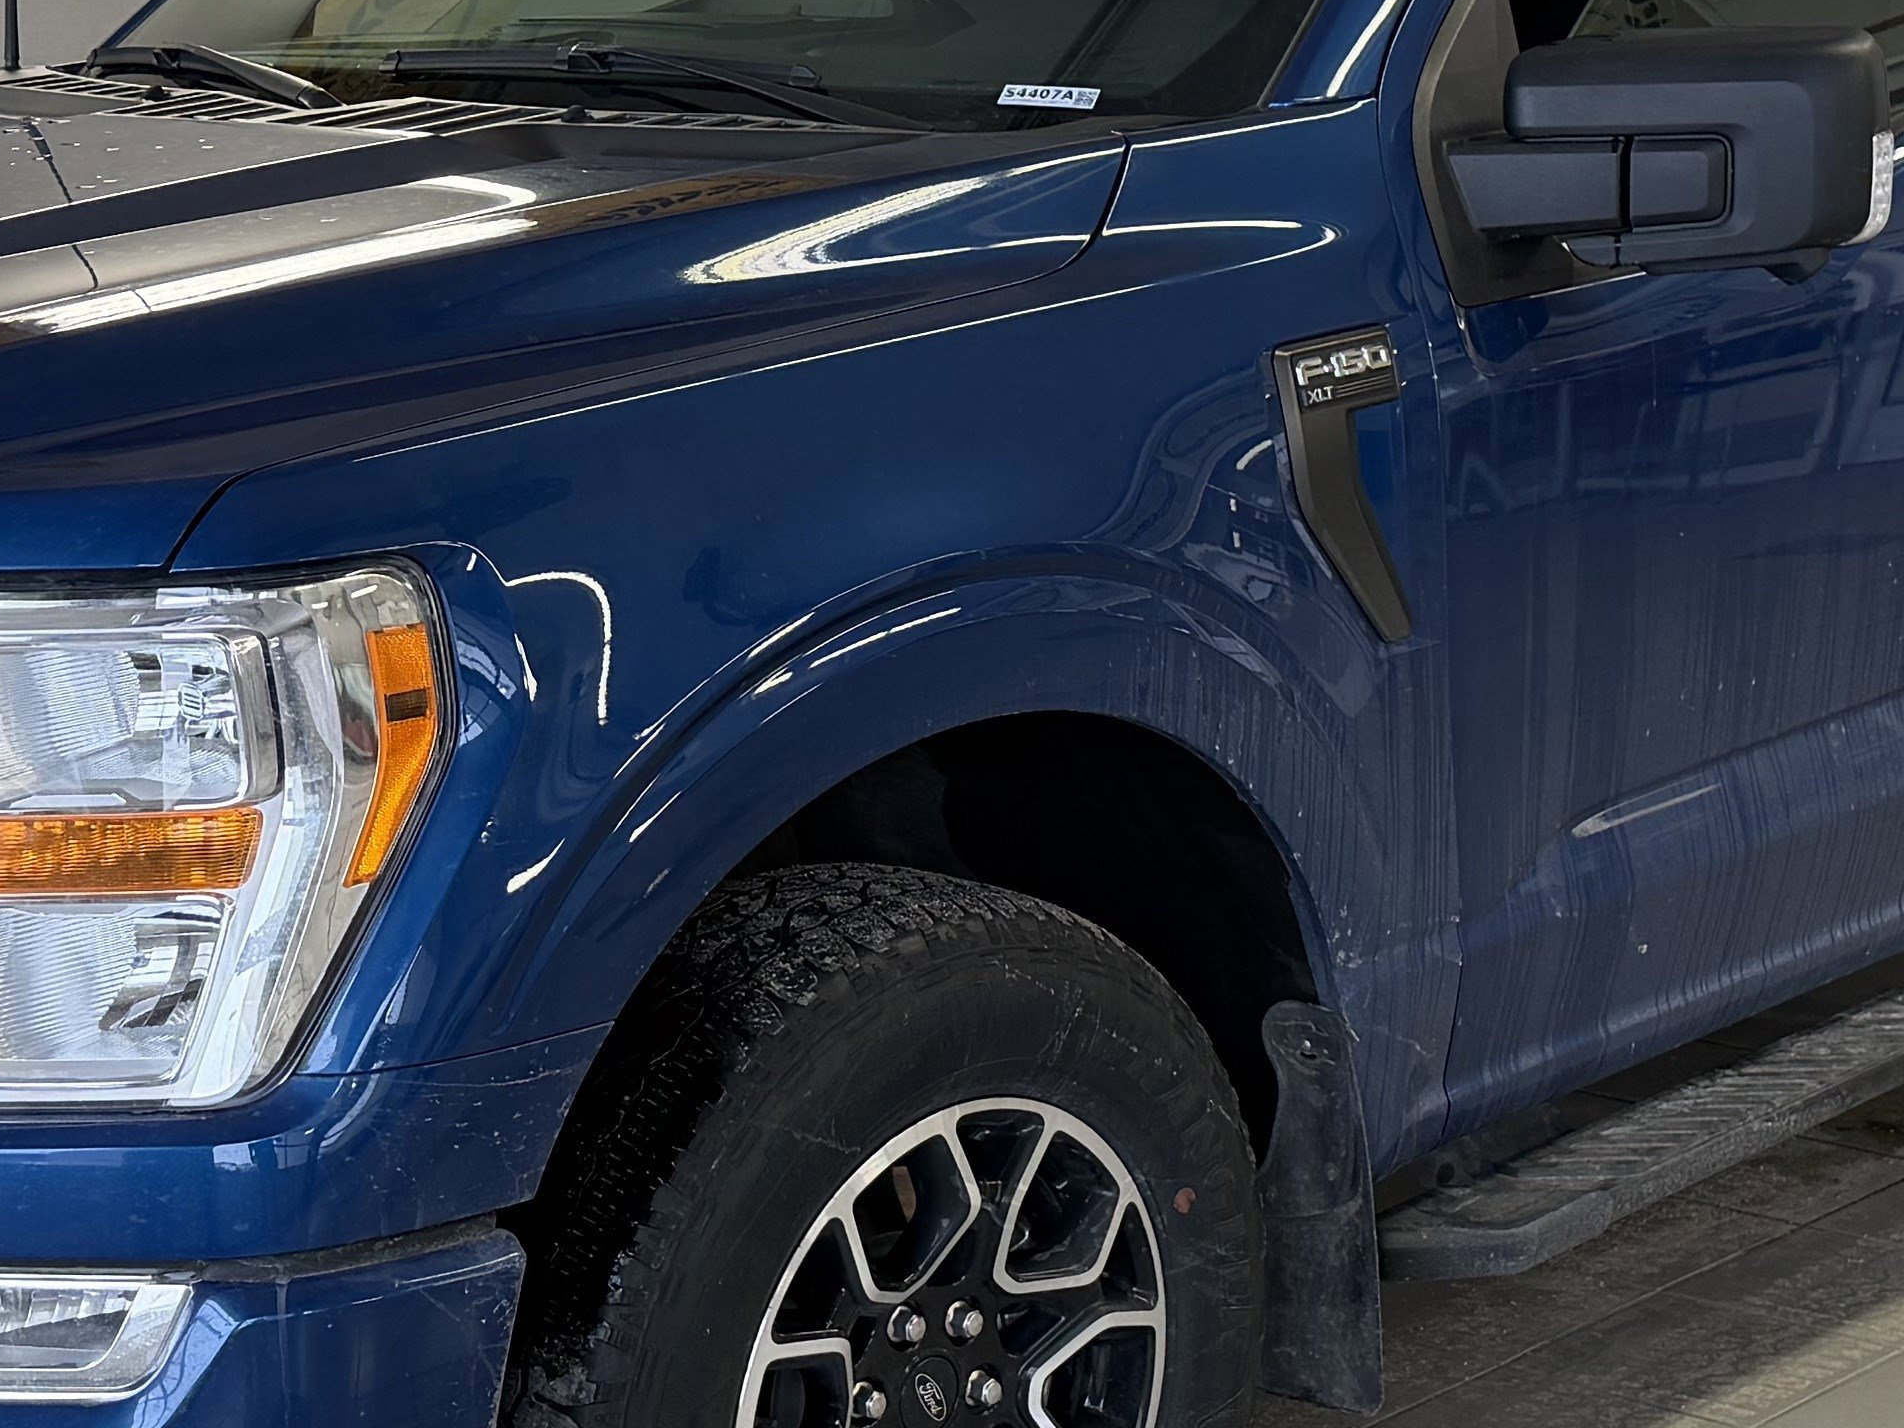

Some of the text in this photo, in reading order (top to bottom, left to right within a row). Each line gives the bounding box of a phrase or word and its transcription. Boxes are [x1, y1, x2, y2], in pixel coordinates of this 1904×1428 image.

[1296, 344, 1392, 386] F-150
[1307, 386, 1334, 404] XLT
[919, 1382, 943, 1415] Ford
